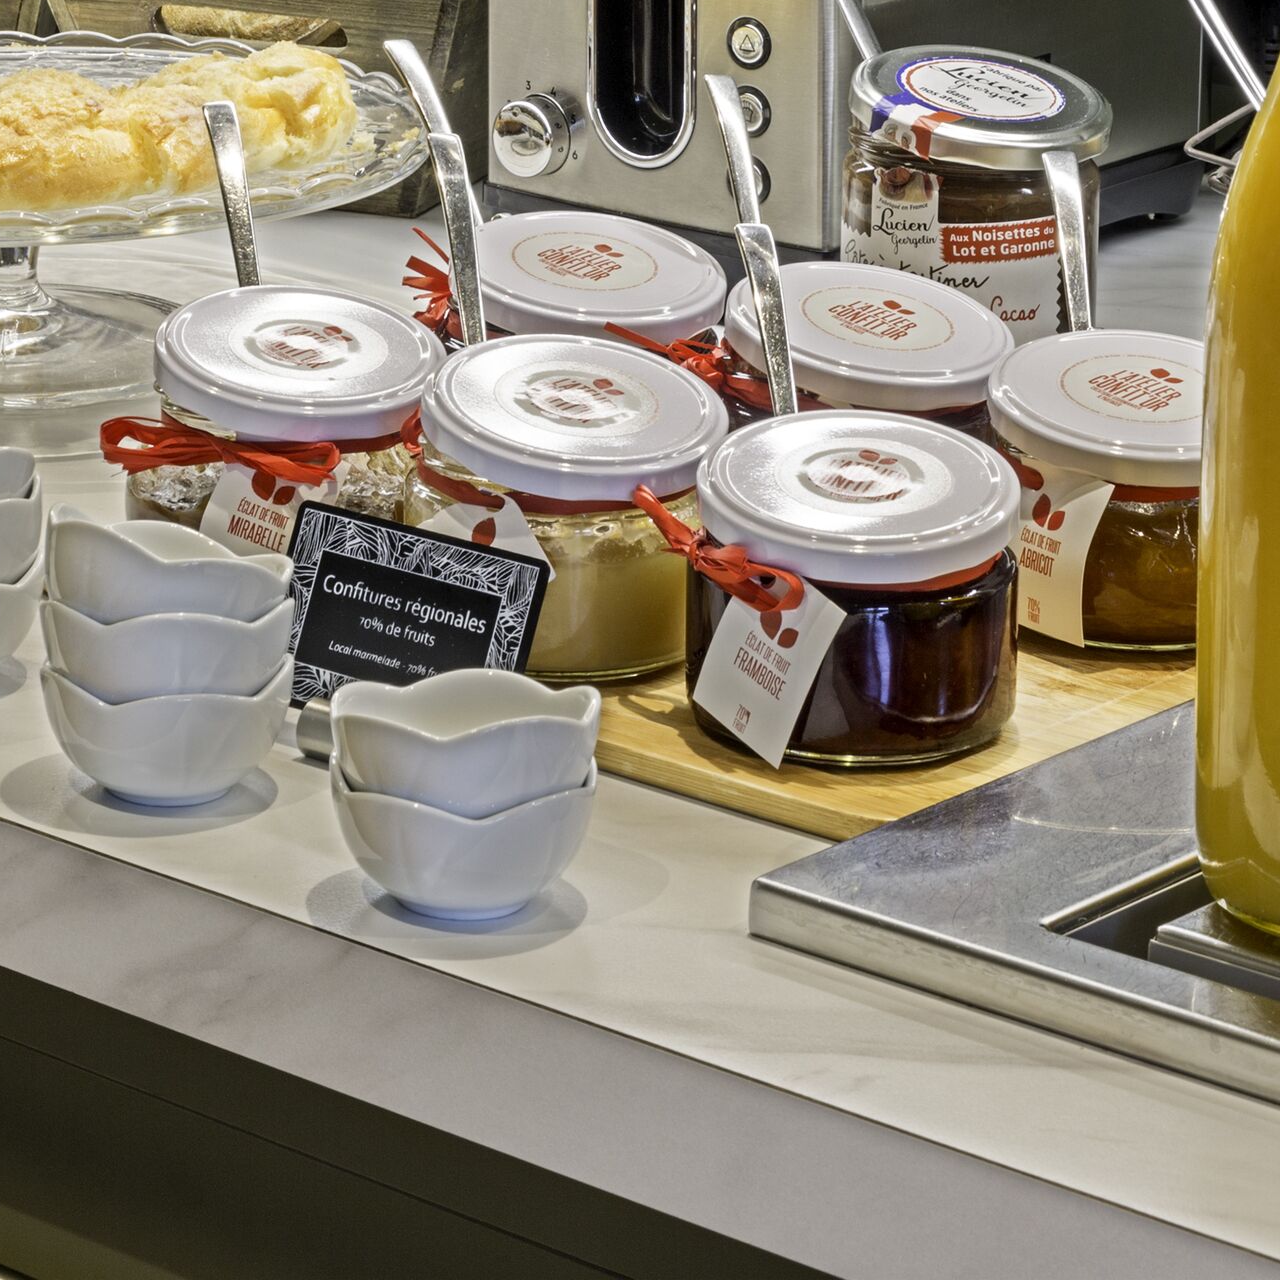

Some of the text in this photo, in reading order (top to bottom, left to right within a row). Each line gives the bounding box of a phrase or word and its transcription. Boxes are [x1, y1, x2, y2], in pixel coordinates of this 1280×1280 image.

[525, 80, 532, 91] 3
[550, 87, 557, 97] 4
[929, 66, 1034, 99] Lucien
[919, 85, 978, 112] nos ateliers
[571, 150, 578, 160] 6
[872, 208, 935, 235] Lucien
[950, 226, 1055, 242] Aux Noisettes du
[559, 245, 622, 273] L'ATELIER
[891, 234, 938, 255] Georgelin
[952, 239, 1055, 257] Lot et Garonne
[847, 300, 918, 331] L'ATELIER
[990, 296, 1041, 322] Cacao
[1111, 369, 1182, 401] L'ATELIER
[237, 496, 290, 530] ÉCLAT DE FRUIT
[227, 515, 286, 553] MIRABELLE
[1021, 525, 1061, 555] ÉCLAT DE FRUIT
[1019, 547, 1055, 577] ABRICOT
[323, 574, 487, 634] Confitures régionales
[359, 616, 436, 647] 70% de fruits
[328, 640, 353, 656] Local
[745, 630, 791, 676] ÉCLAT DE FRUIT
[733, 647, 786, 700] FRAMBOISE
